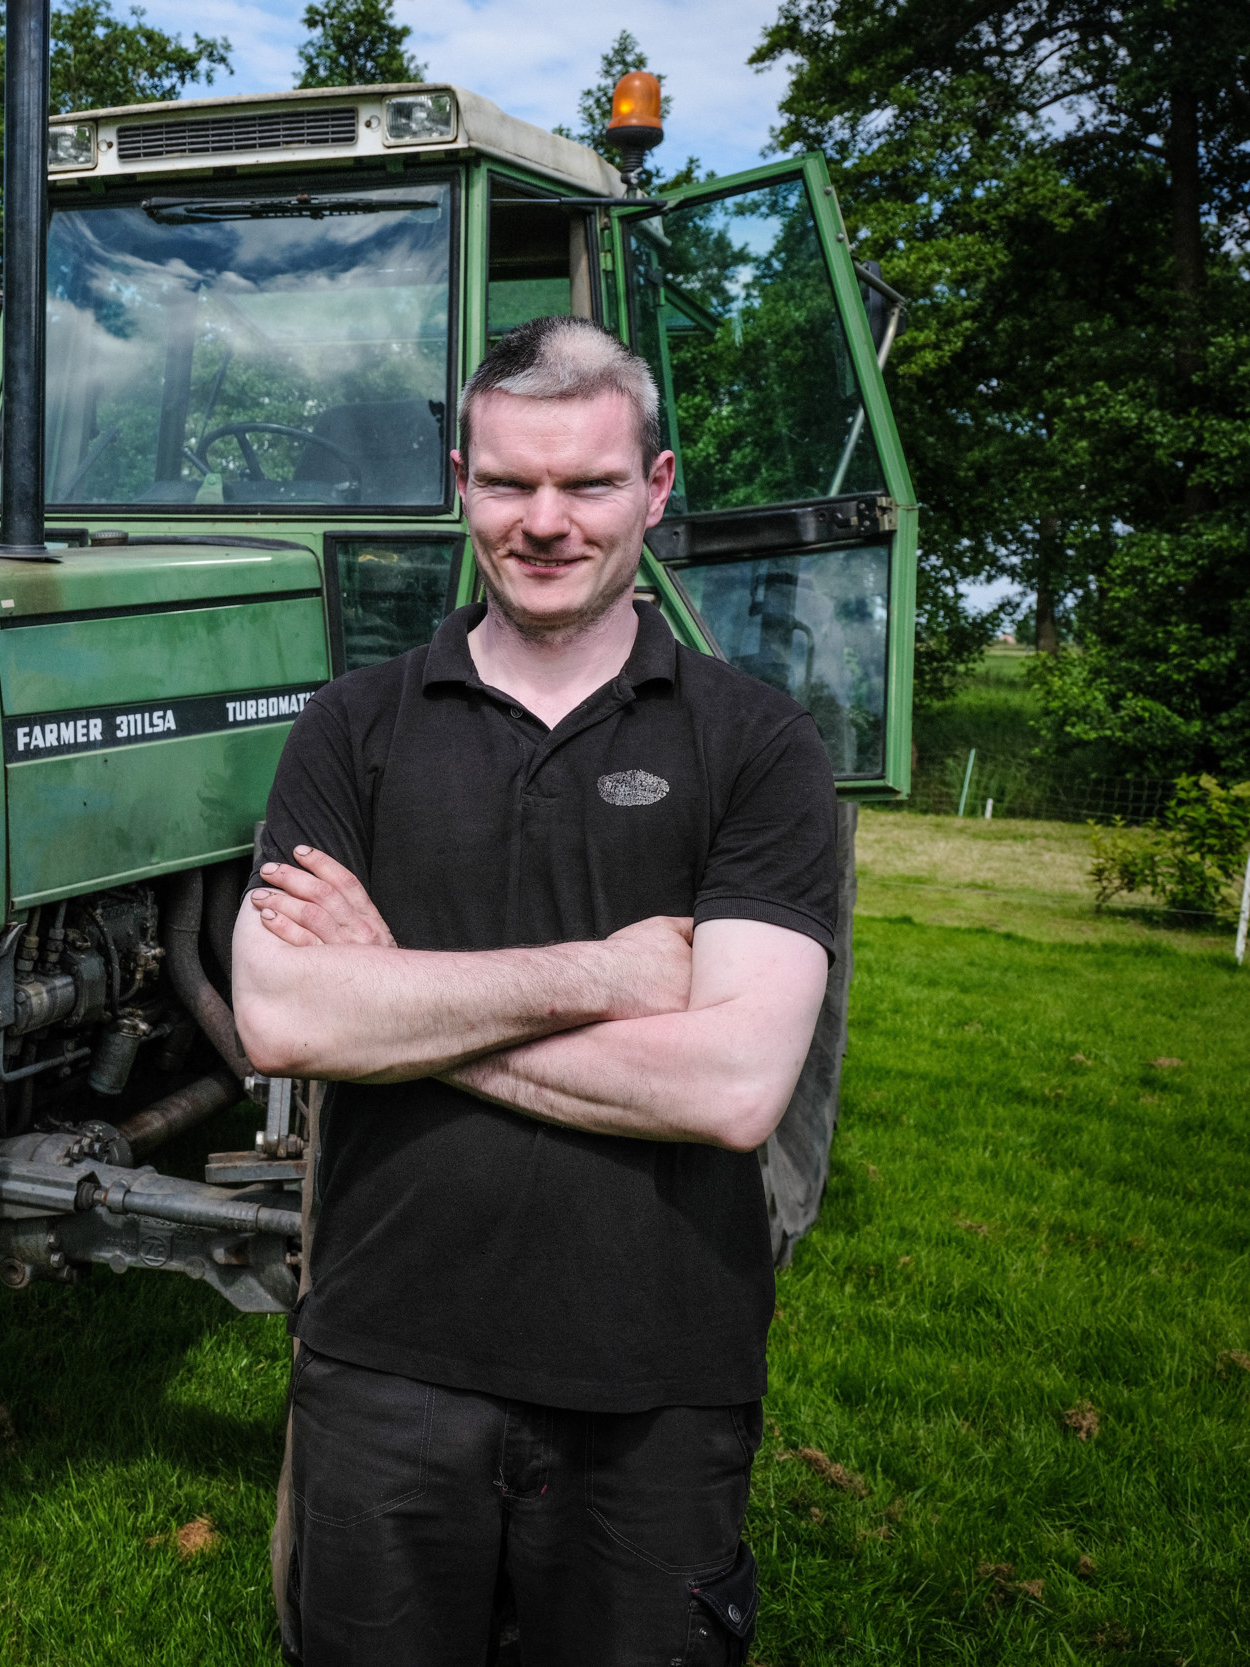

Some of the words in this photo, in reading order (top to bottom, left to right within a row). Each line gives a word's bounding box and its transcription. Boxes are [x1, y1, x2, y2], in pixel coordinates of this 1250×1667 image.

[17, 718, 103, 751] FARMER
[116, 710, 176, 738] 311LSA
[226, 692, 316, 722] TURBOMAT
